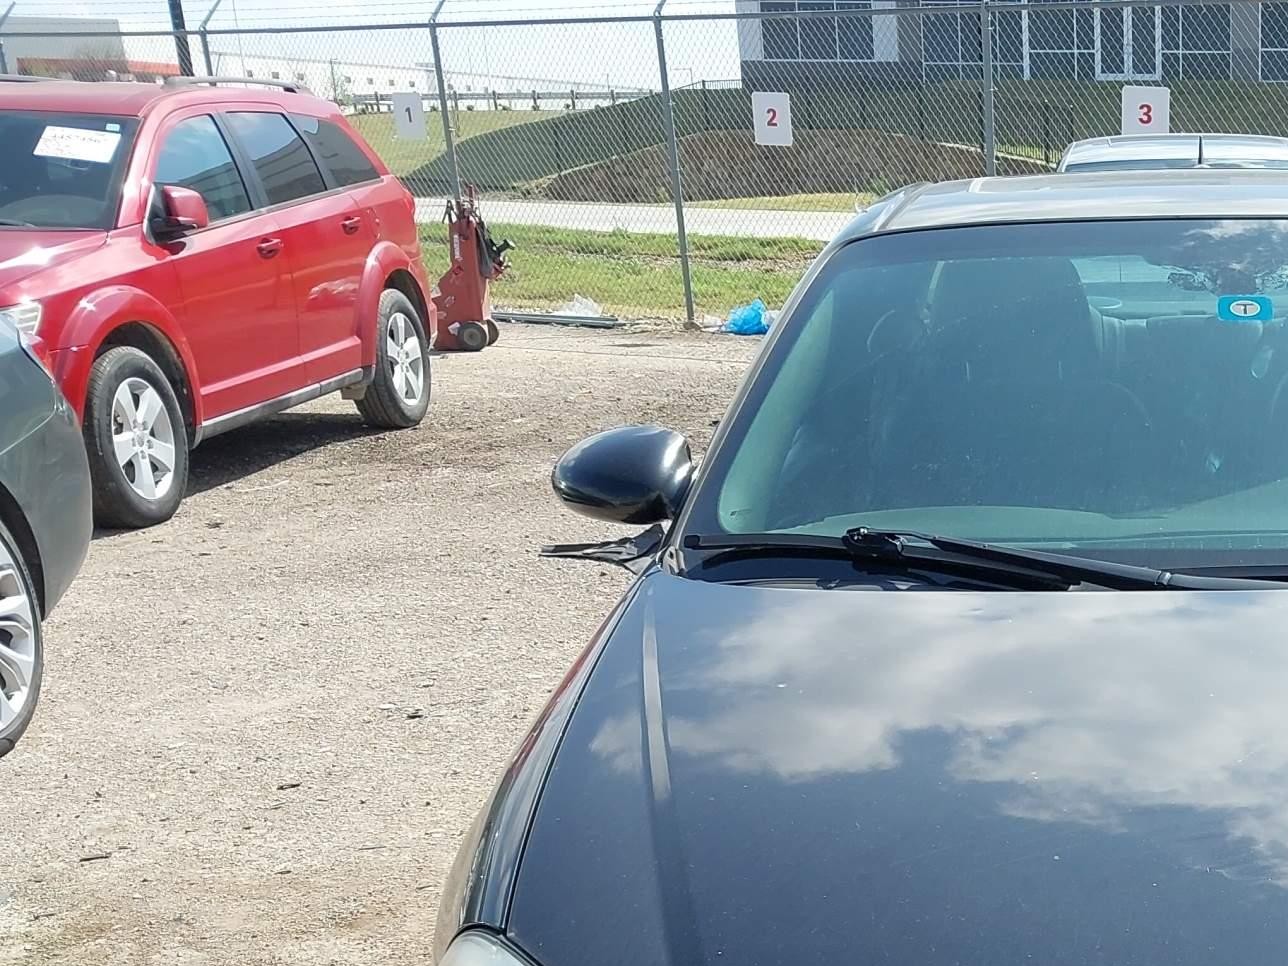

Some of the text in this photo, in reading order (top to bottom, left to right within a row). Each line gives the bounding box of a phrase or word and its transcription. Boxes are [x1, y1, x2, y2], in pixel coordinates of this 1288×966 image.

[404, 106, 413, 123] 1
[766, 108, 778, 127] 2
[1138, 103, 1152, 125] 3
